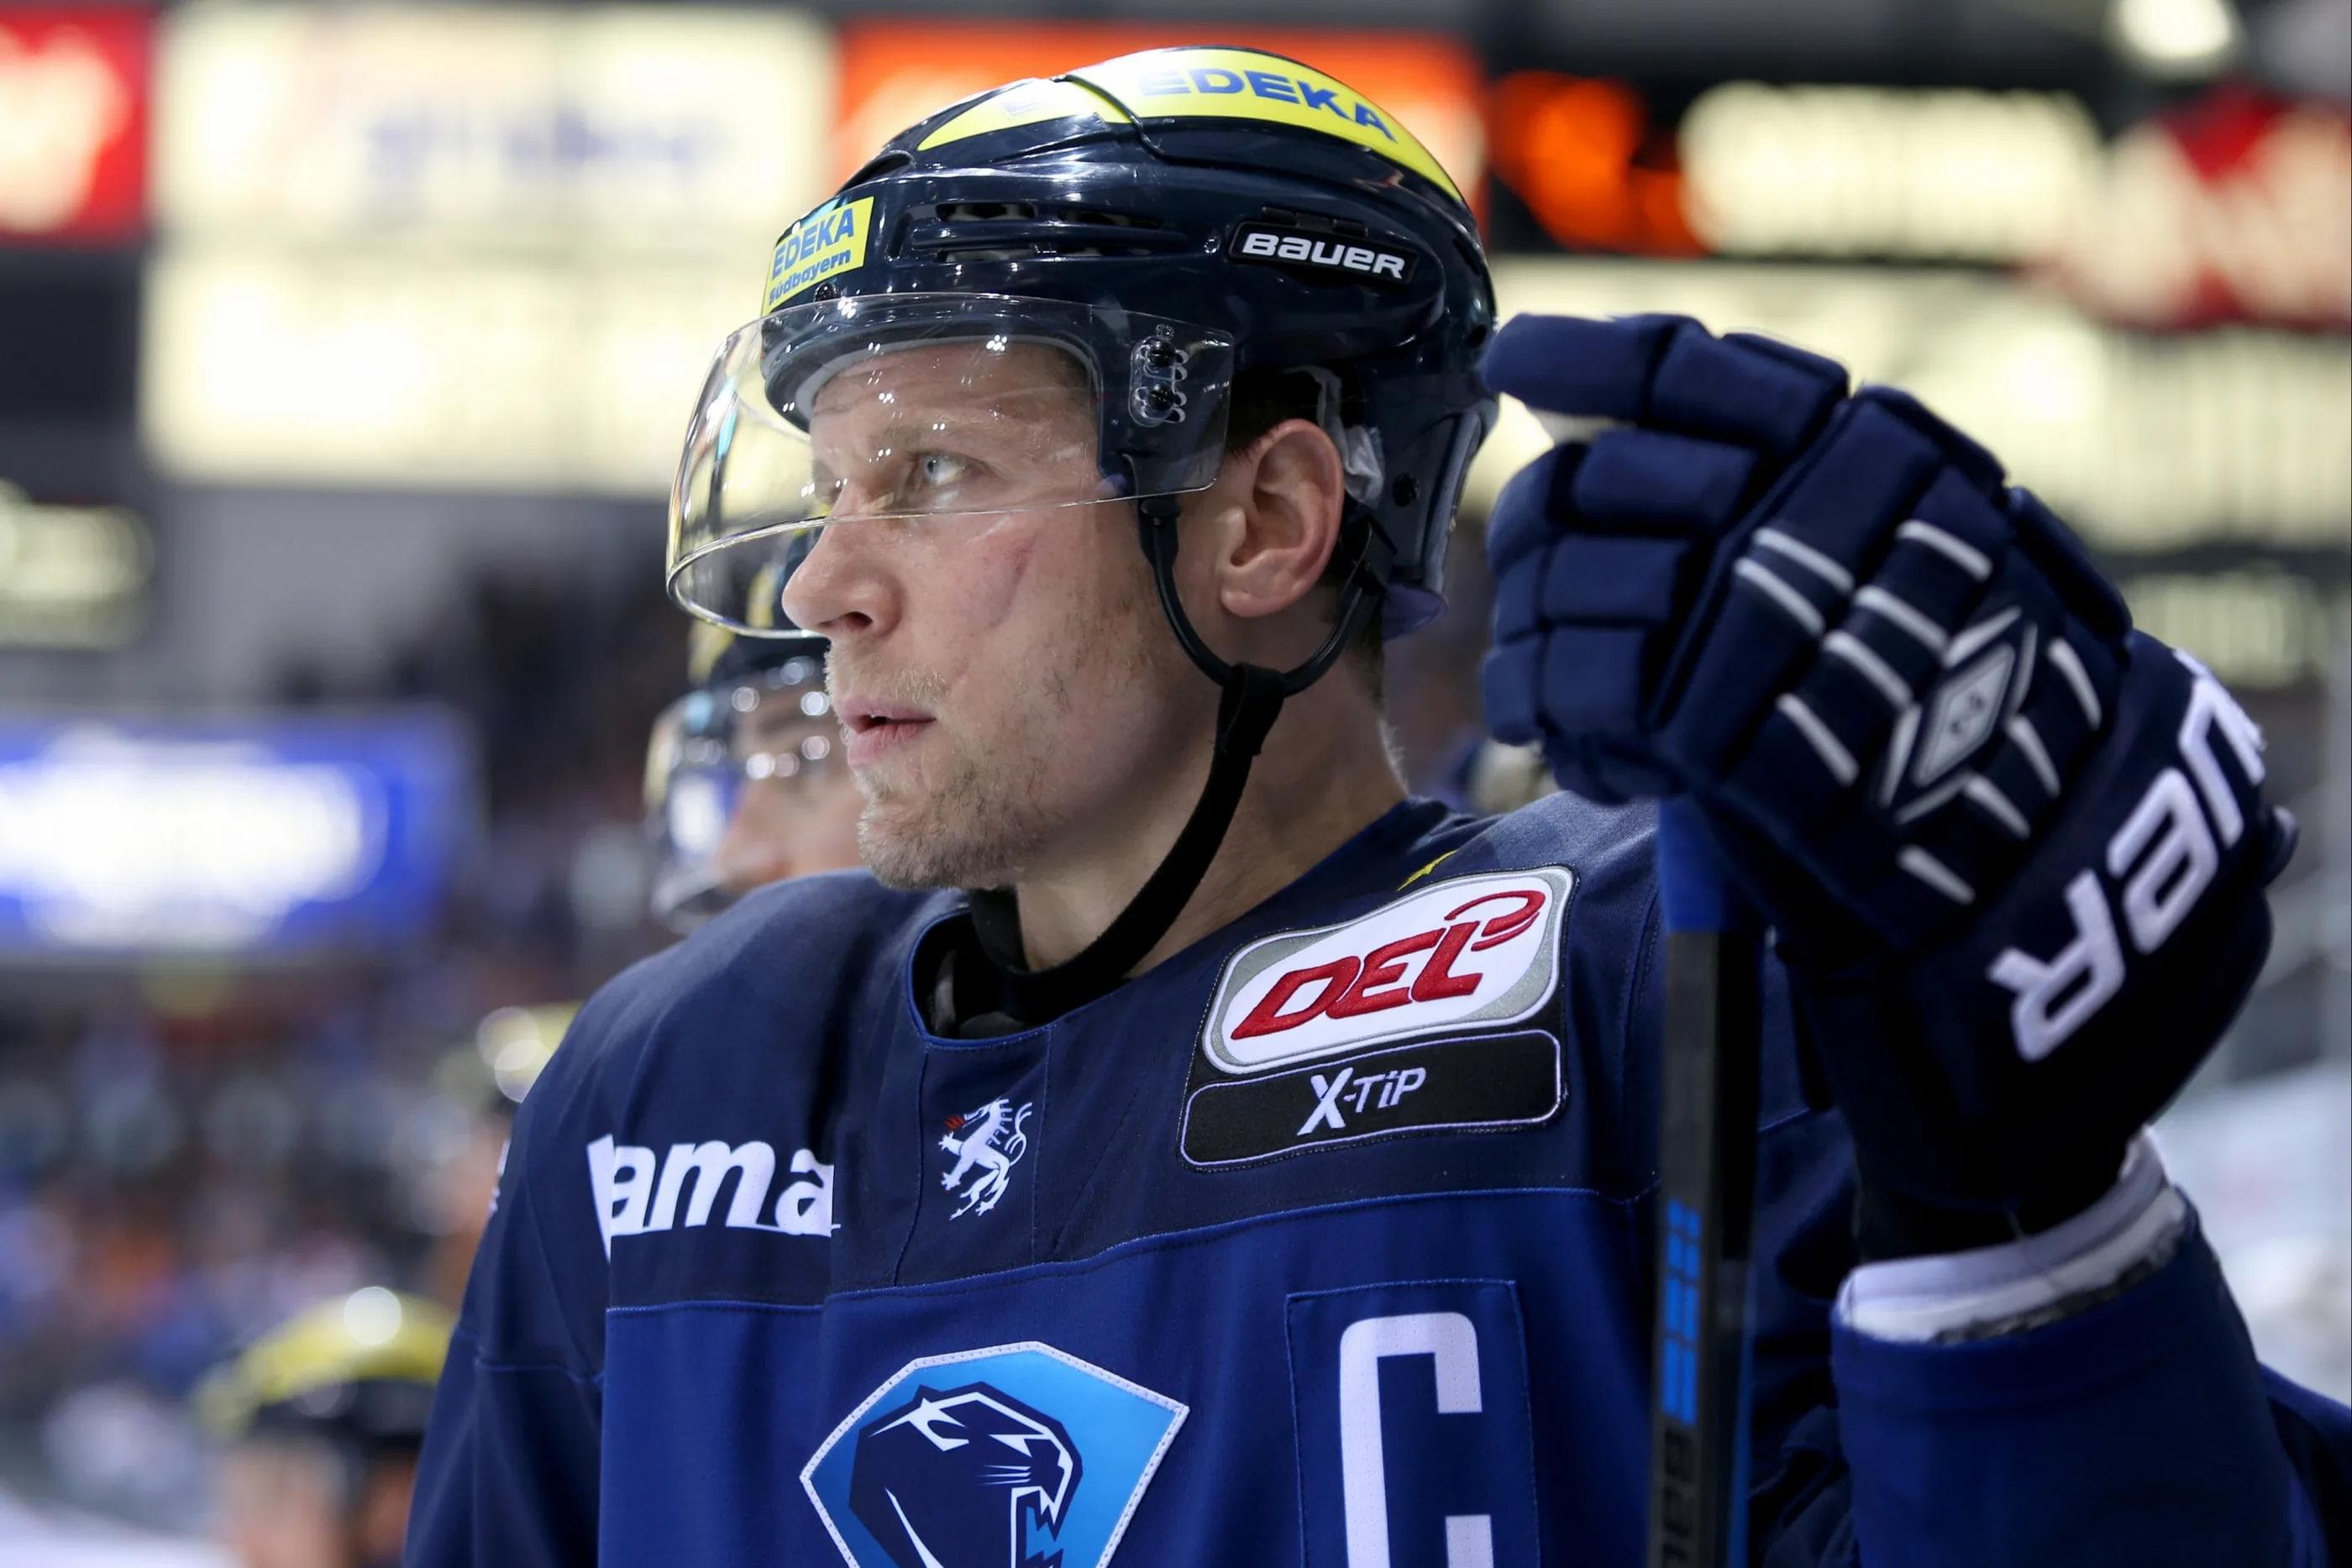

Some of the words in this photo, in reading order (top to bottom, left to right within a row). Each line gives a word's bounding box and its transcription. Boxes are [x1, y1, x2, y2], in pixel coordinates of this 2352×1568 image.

[1139, 67, 1399, 145] EDEKA
[772, 207, 854, 281] EDEKA
[1242, 233, 1405, 280] BAUER
[1987, 647, 2267, 1062] UER
[1230, 920, 1483, 1041] DEL
[1340, 1311, 1494, 1568] C
